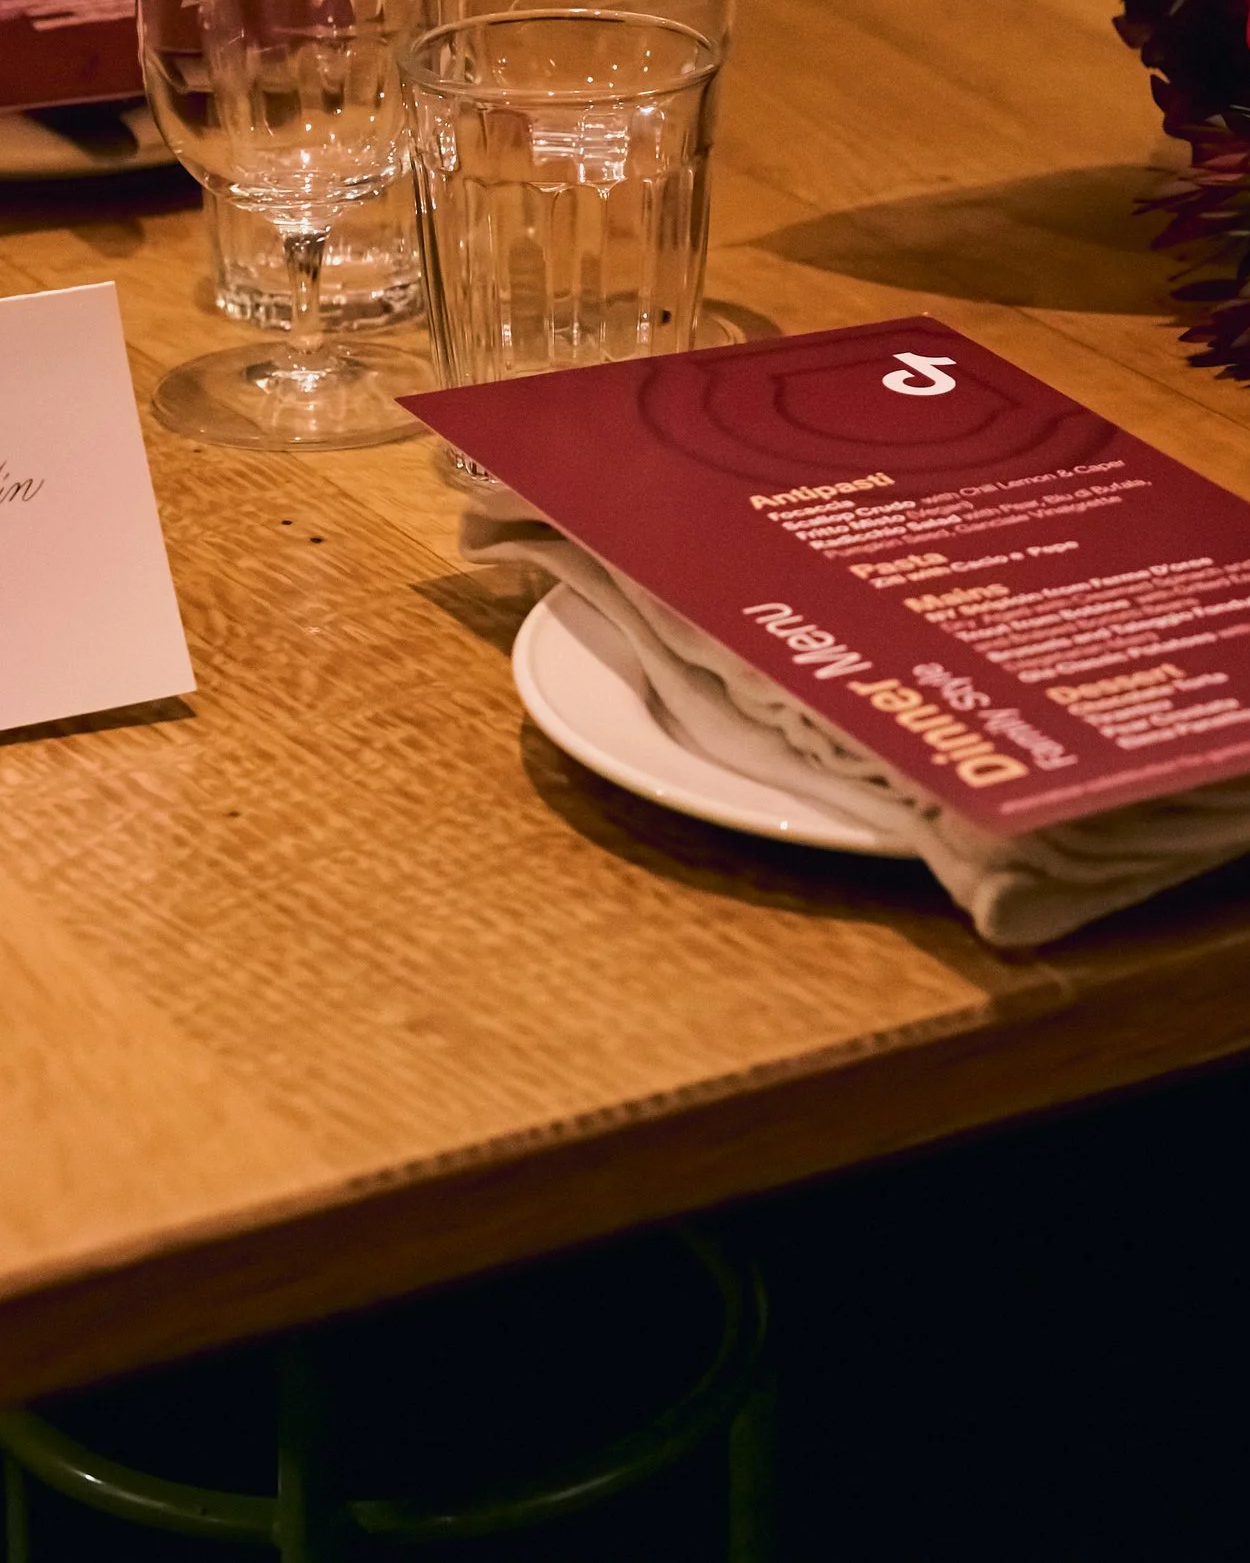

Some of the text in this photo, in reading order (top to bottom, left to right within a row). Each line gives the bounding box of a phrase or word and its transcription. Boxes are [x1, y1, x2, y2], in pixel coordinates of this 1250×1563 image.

[749, 472, 895, 510] Antipasti
[766, 500, 856, 521] Focaccia
[782, 512, 855, 530] Scallop
[856, 501, 914, 516] Crudo
[920, 492, 960, 504] with
[997, 474, 1057, 489] Lemon
[1074, 460, 1124, 474] Caper
[794, 525, 850, 540] Fritto
[906, 514, 962, 530] Salad
[960, 508, 1000, 520] with
[849, 553, 949, 579] Pasta
[903, 583, 1010, 614] Mains
[742, 602, 873, 680] Menu
[911, 662, 991, 712] Style
[1046, 663, 1186, 705] Dessert
[846, 678, 1030, 788] Dinner
[977, 707, 1079, 771] Family
